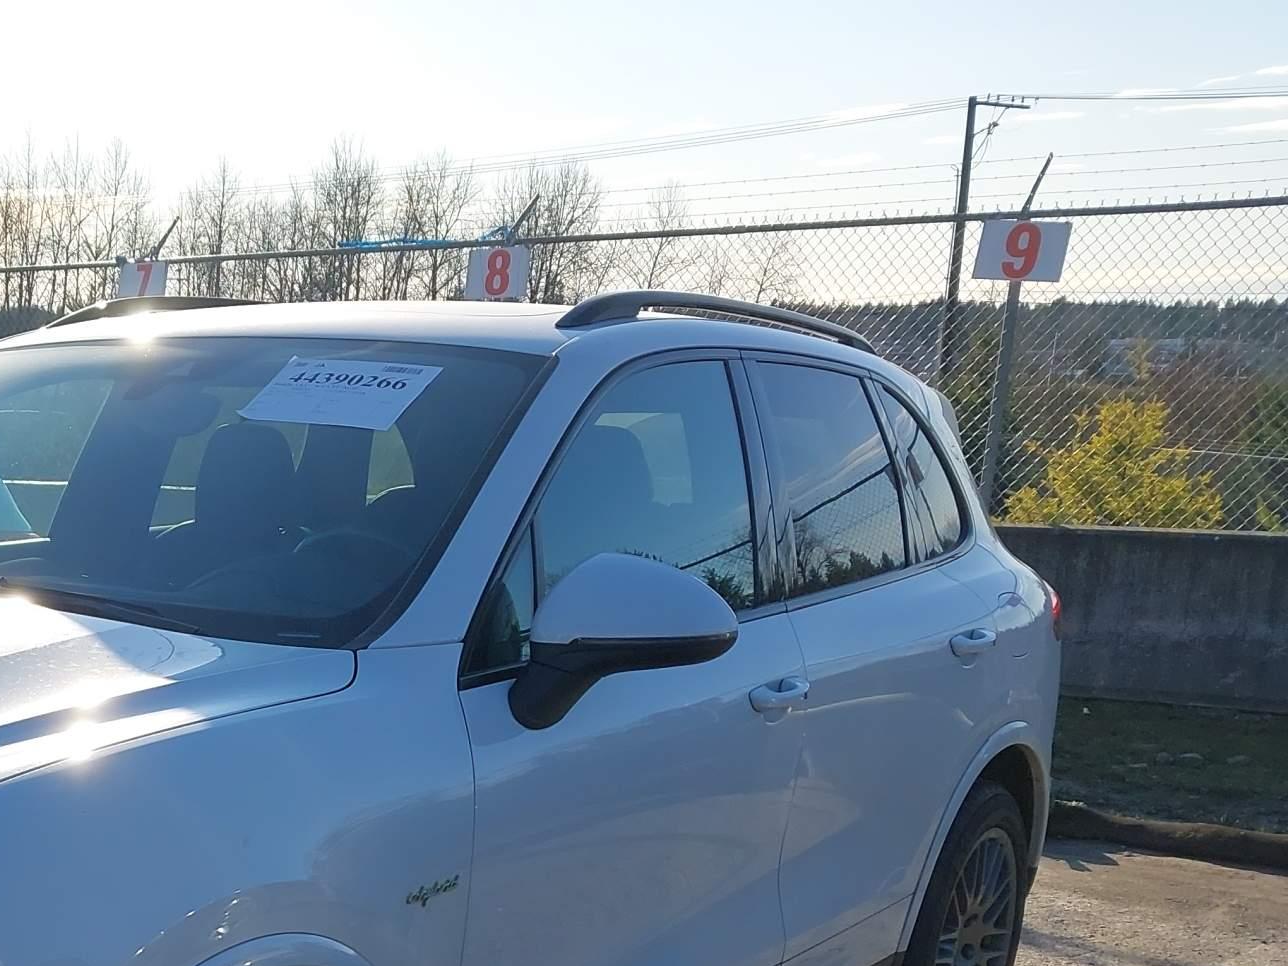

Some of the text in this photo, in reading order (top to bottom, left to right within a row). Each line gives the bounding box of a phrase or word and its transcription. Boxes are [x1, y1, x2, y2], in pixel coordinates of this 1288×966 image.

[1001, 222, 1042, 279] 9
[136, 263, 153, 296] 7
[485, 249, 511, 296] 8
[288, 371, 410, 391] 44390266
